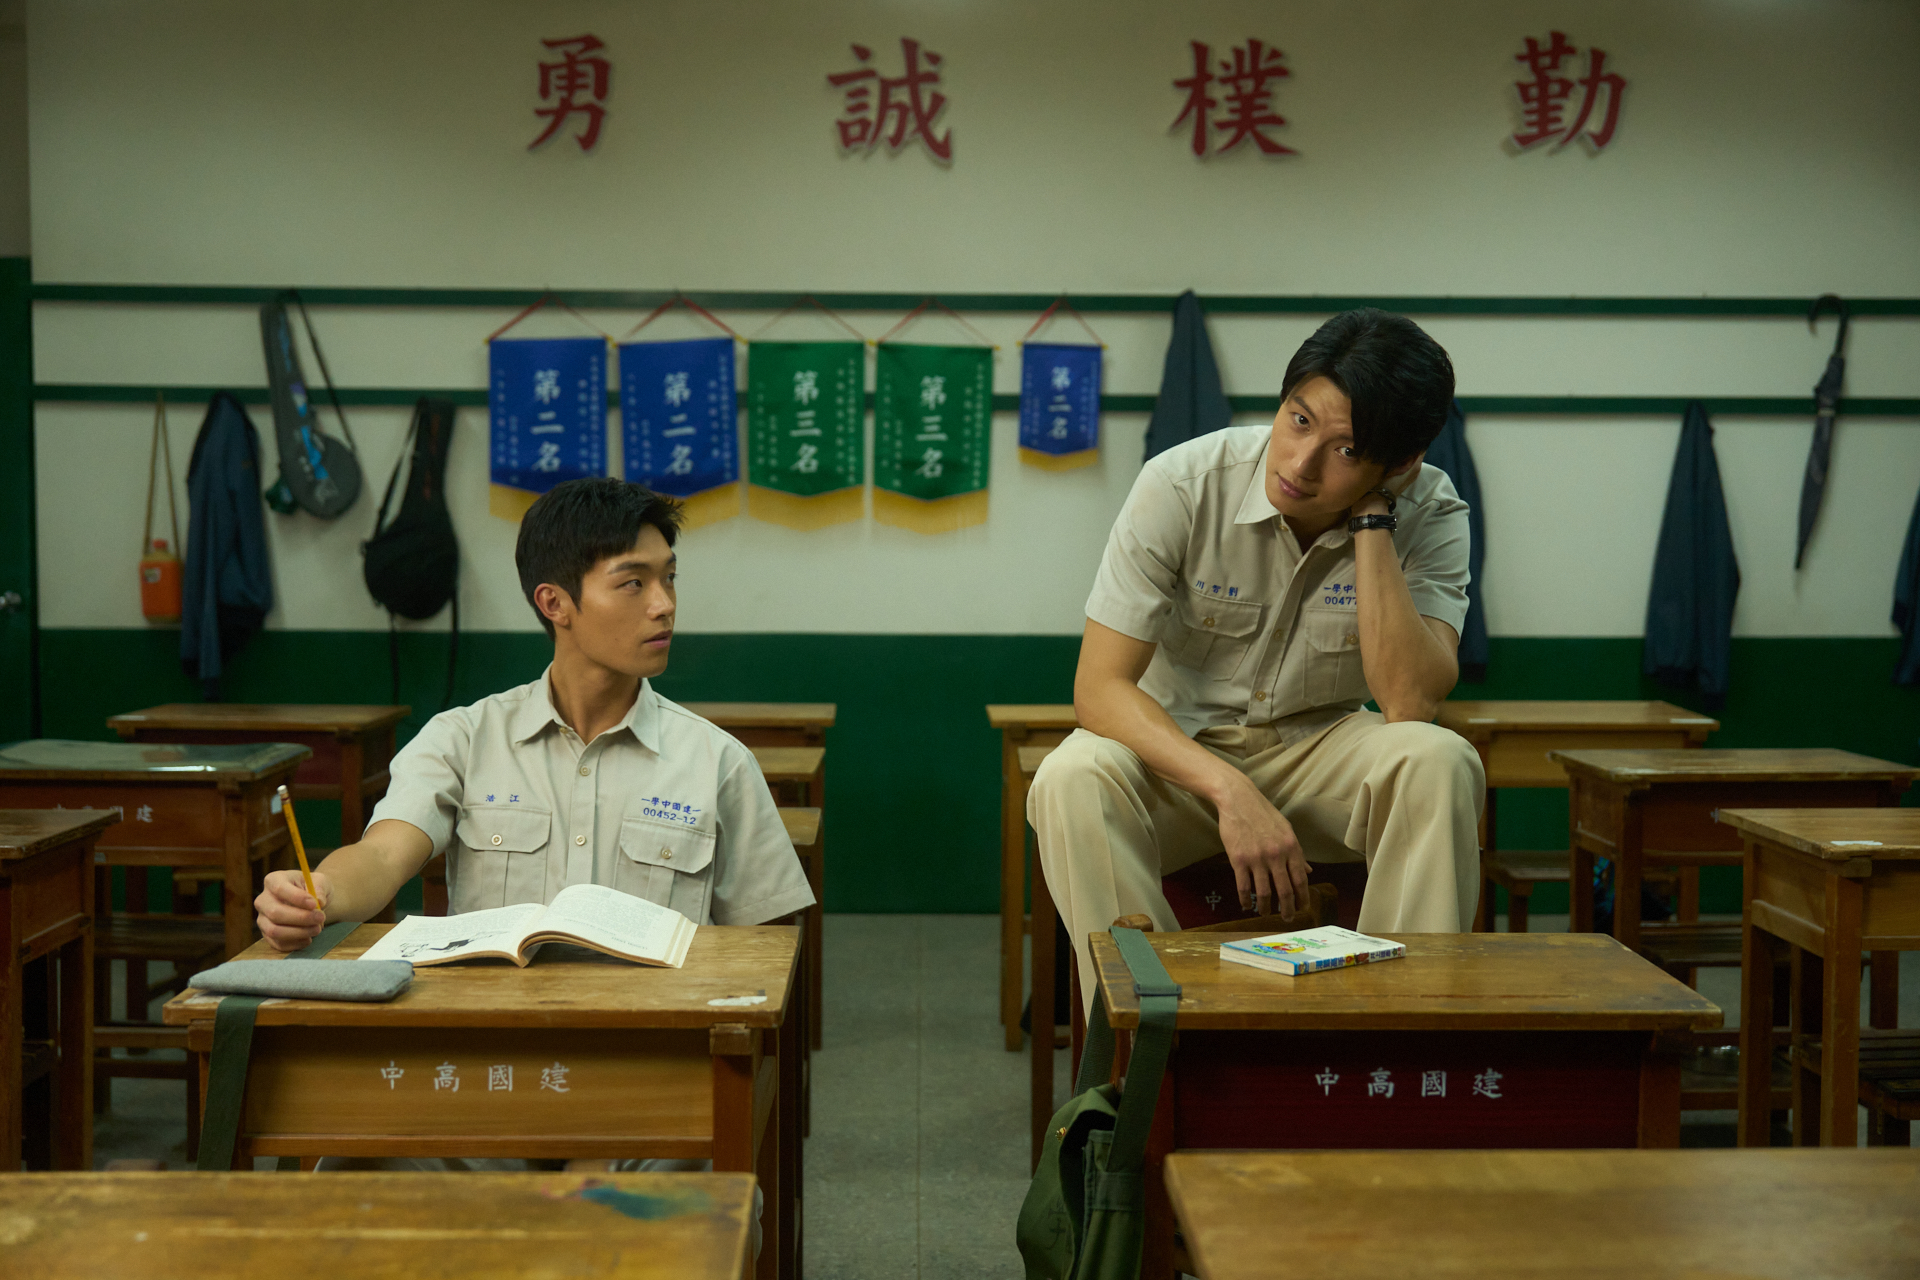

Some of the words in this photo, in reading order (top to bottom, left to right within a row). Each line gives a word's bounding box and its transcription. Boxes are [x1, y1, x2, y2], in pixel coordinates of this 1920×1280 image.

[527, 34, 612, 151] 勇
[826, 37, 953, 160] 誠
[1169, 38, 1300, 156] 樸
[1513, 30, 1627, 148] 勤
[530, 369, 565, 472] 第二名
[662, 371, 697, 475] 第二名
[789, 370, 823, 473] 第三名
[915, 375, 948, 479] 第三名
[643, 807, 697, 825] 00452-12
